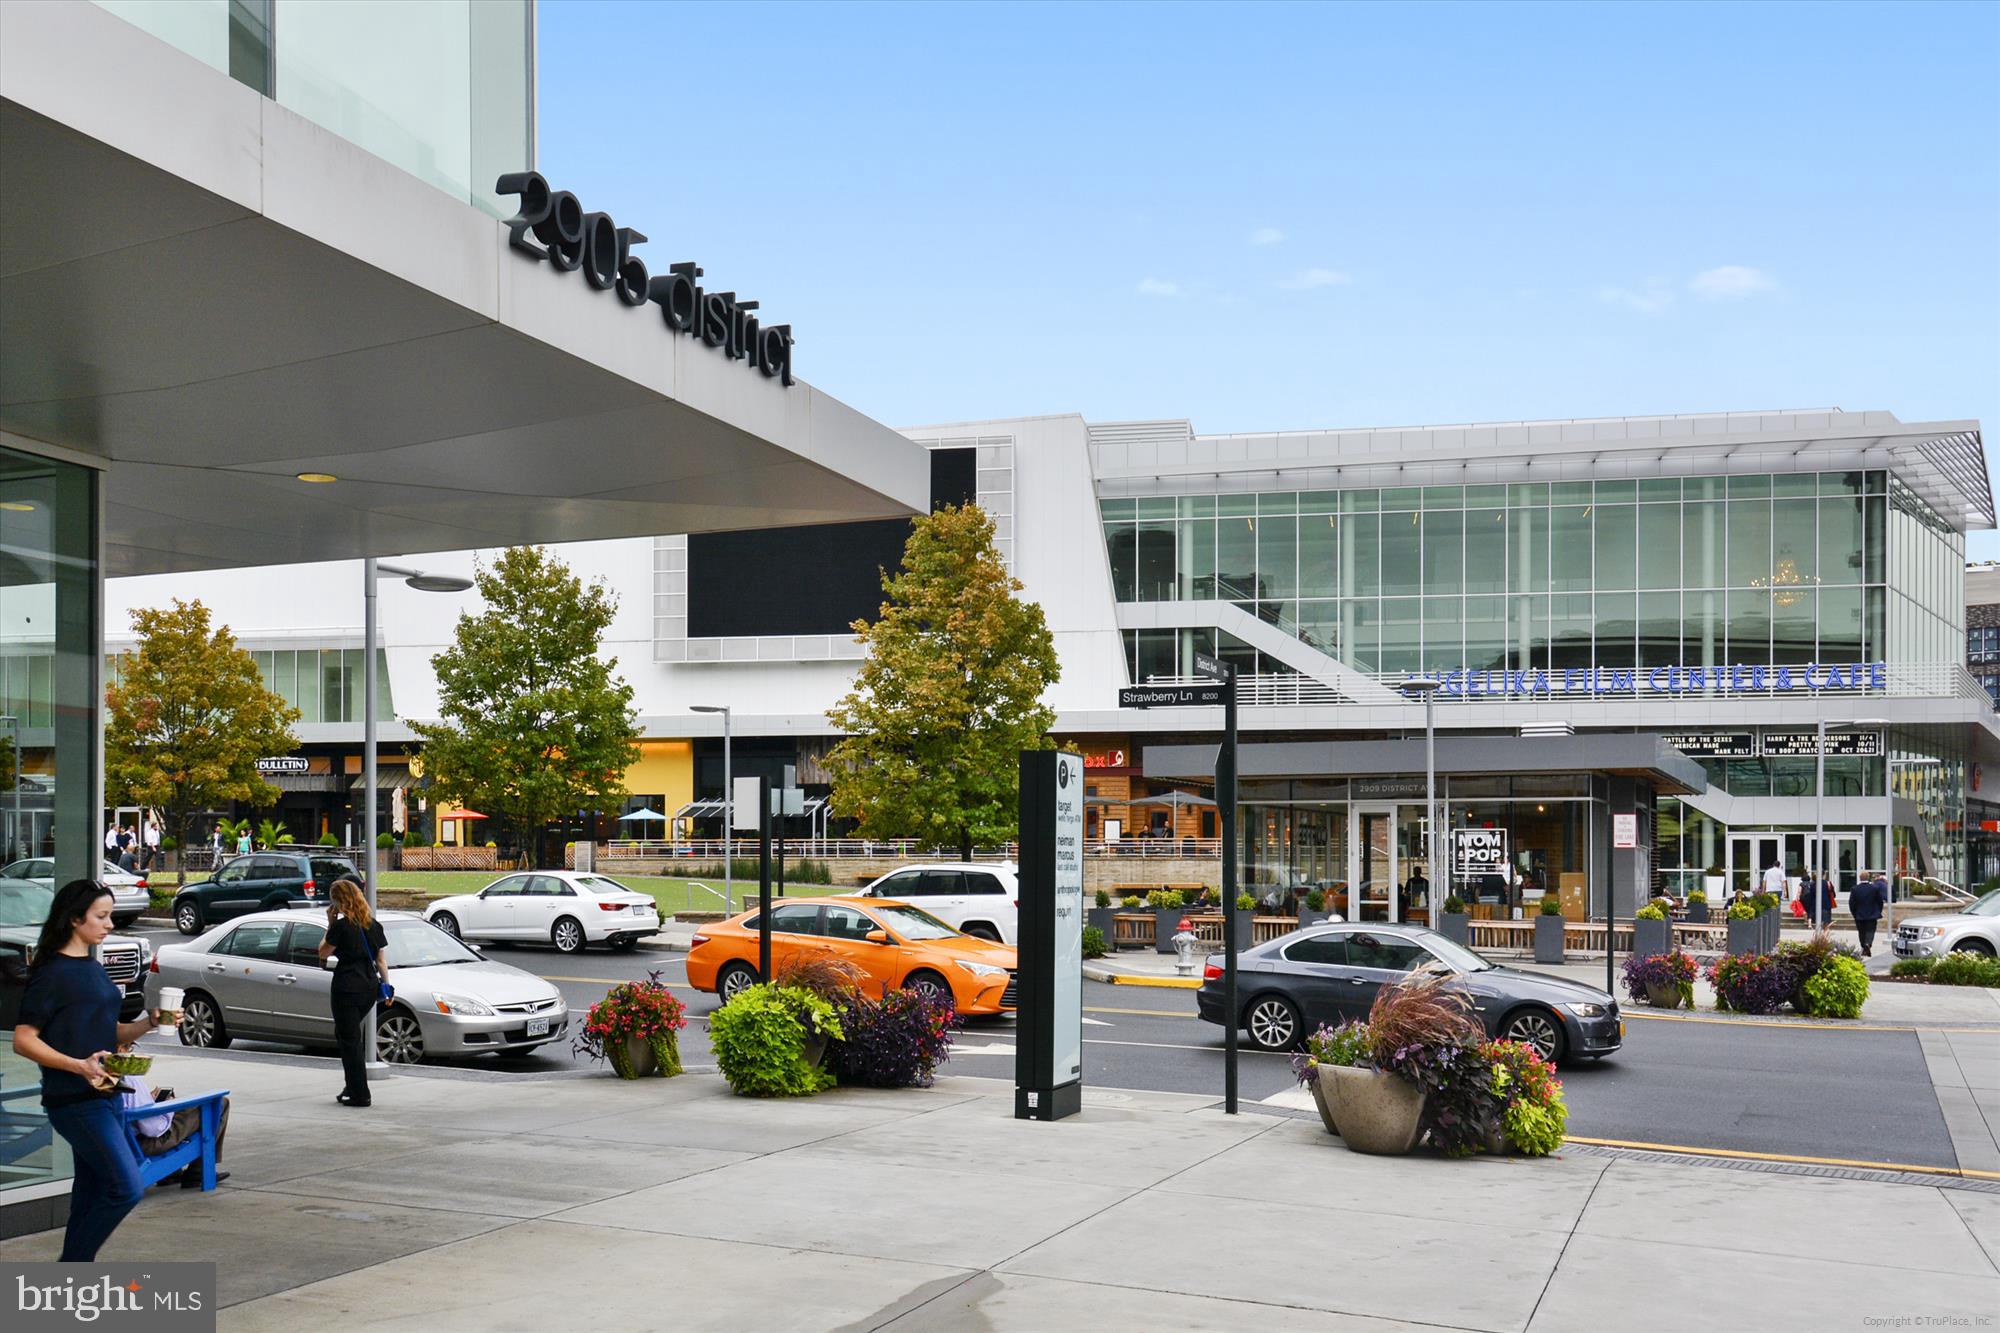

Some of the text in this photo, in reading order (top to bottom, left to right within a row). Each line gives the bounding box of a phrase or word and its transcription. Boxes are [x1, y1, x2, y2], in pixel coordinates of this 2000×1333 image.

[496, 171, 796, 387] 2905 district
[1564, 668, 1636, 693] FILM
[1649, 665, 1766, 692] CENTER
[1776, 667, 1793, 689] &
[1804, 663, 1888, 689] CAFE
[1122, 690, 1219, 703] Strawberry Ln 8200
[259, 760, 304, 769] BULLETIN
[1382, 784, 1419, 792] DISTRICT
[1058, 800, 1072, 815] target
[1458, 834, 1501, 847] MOM
[1466, 849, 1501, 861] POP
